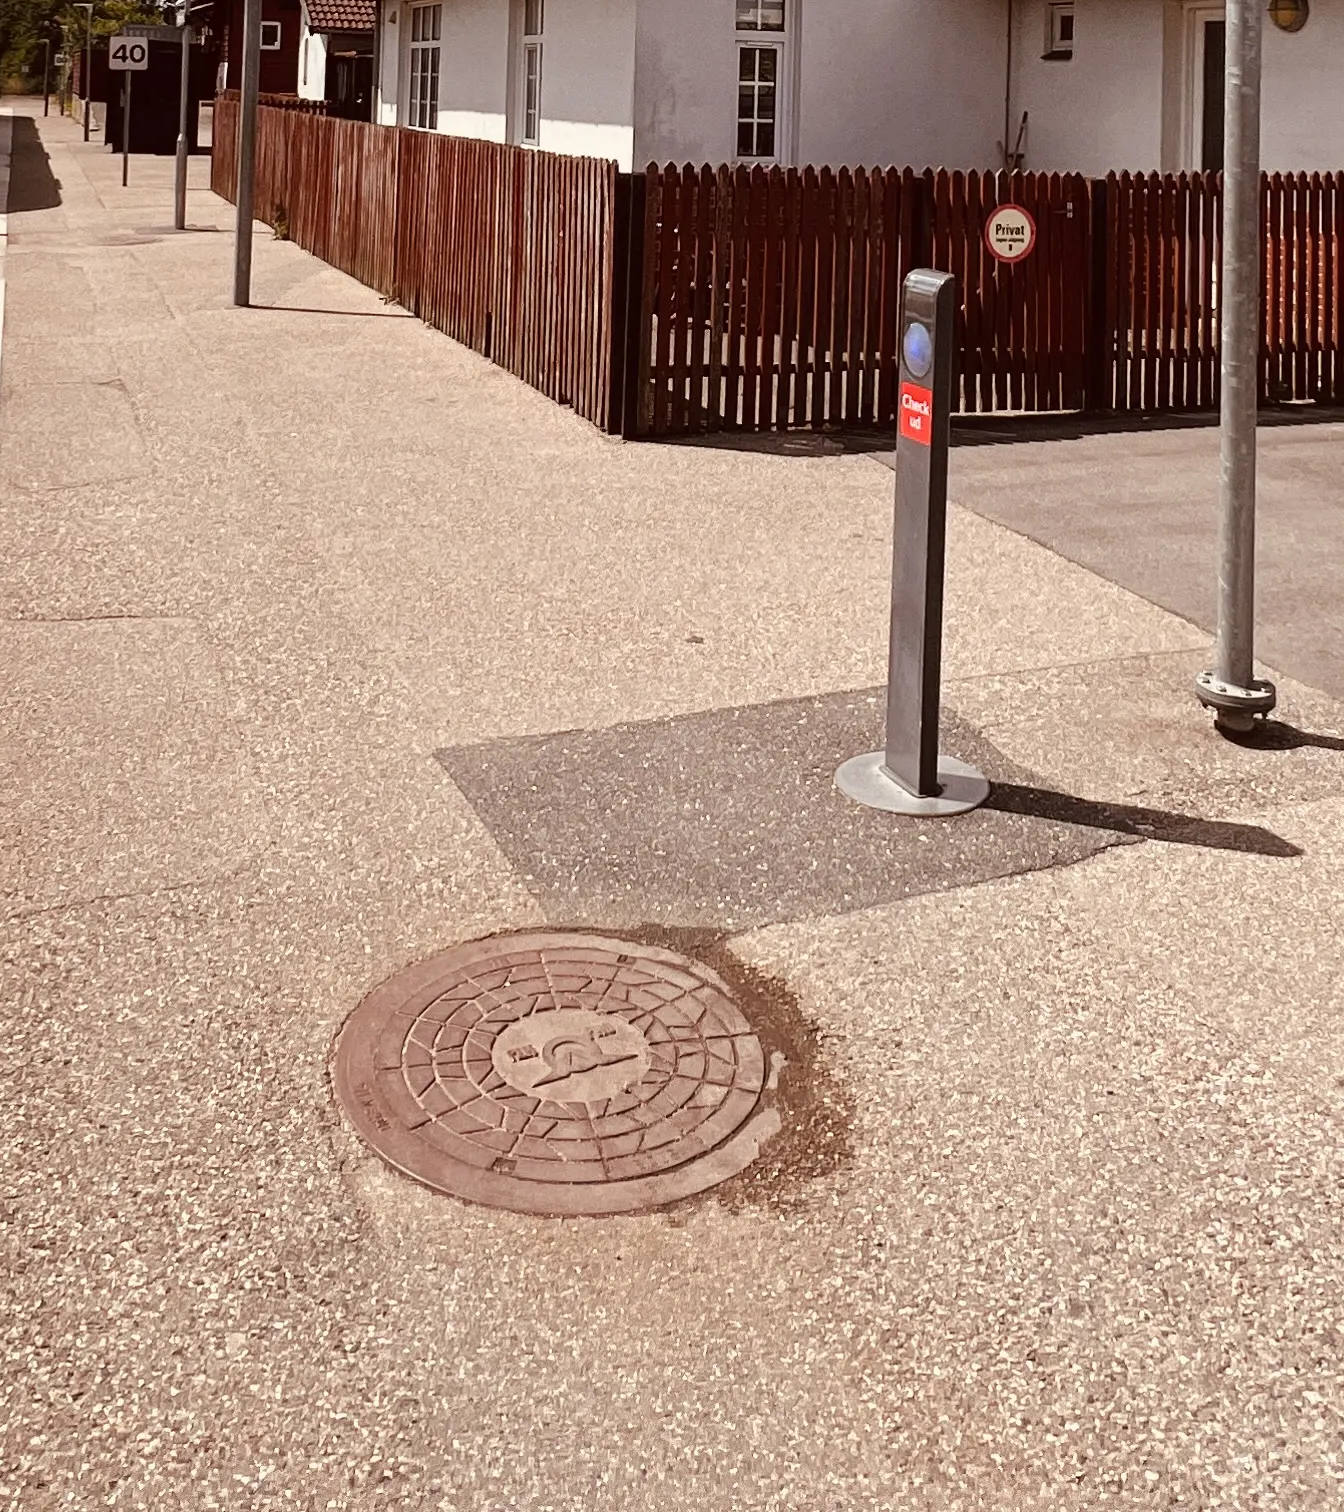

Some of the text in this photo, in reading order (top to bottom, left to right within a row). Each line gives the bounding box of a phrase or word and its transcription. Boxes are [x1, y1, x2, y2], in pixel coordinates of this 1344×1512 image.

[112, 44, 146, 63] 40
[995, 223, 1025, 236] Privat
[901, 393, 930, 416] Check
[910, 416, 922, 430] ud
